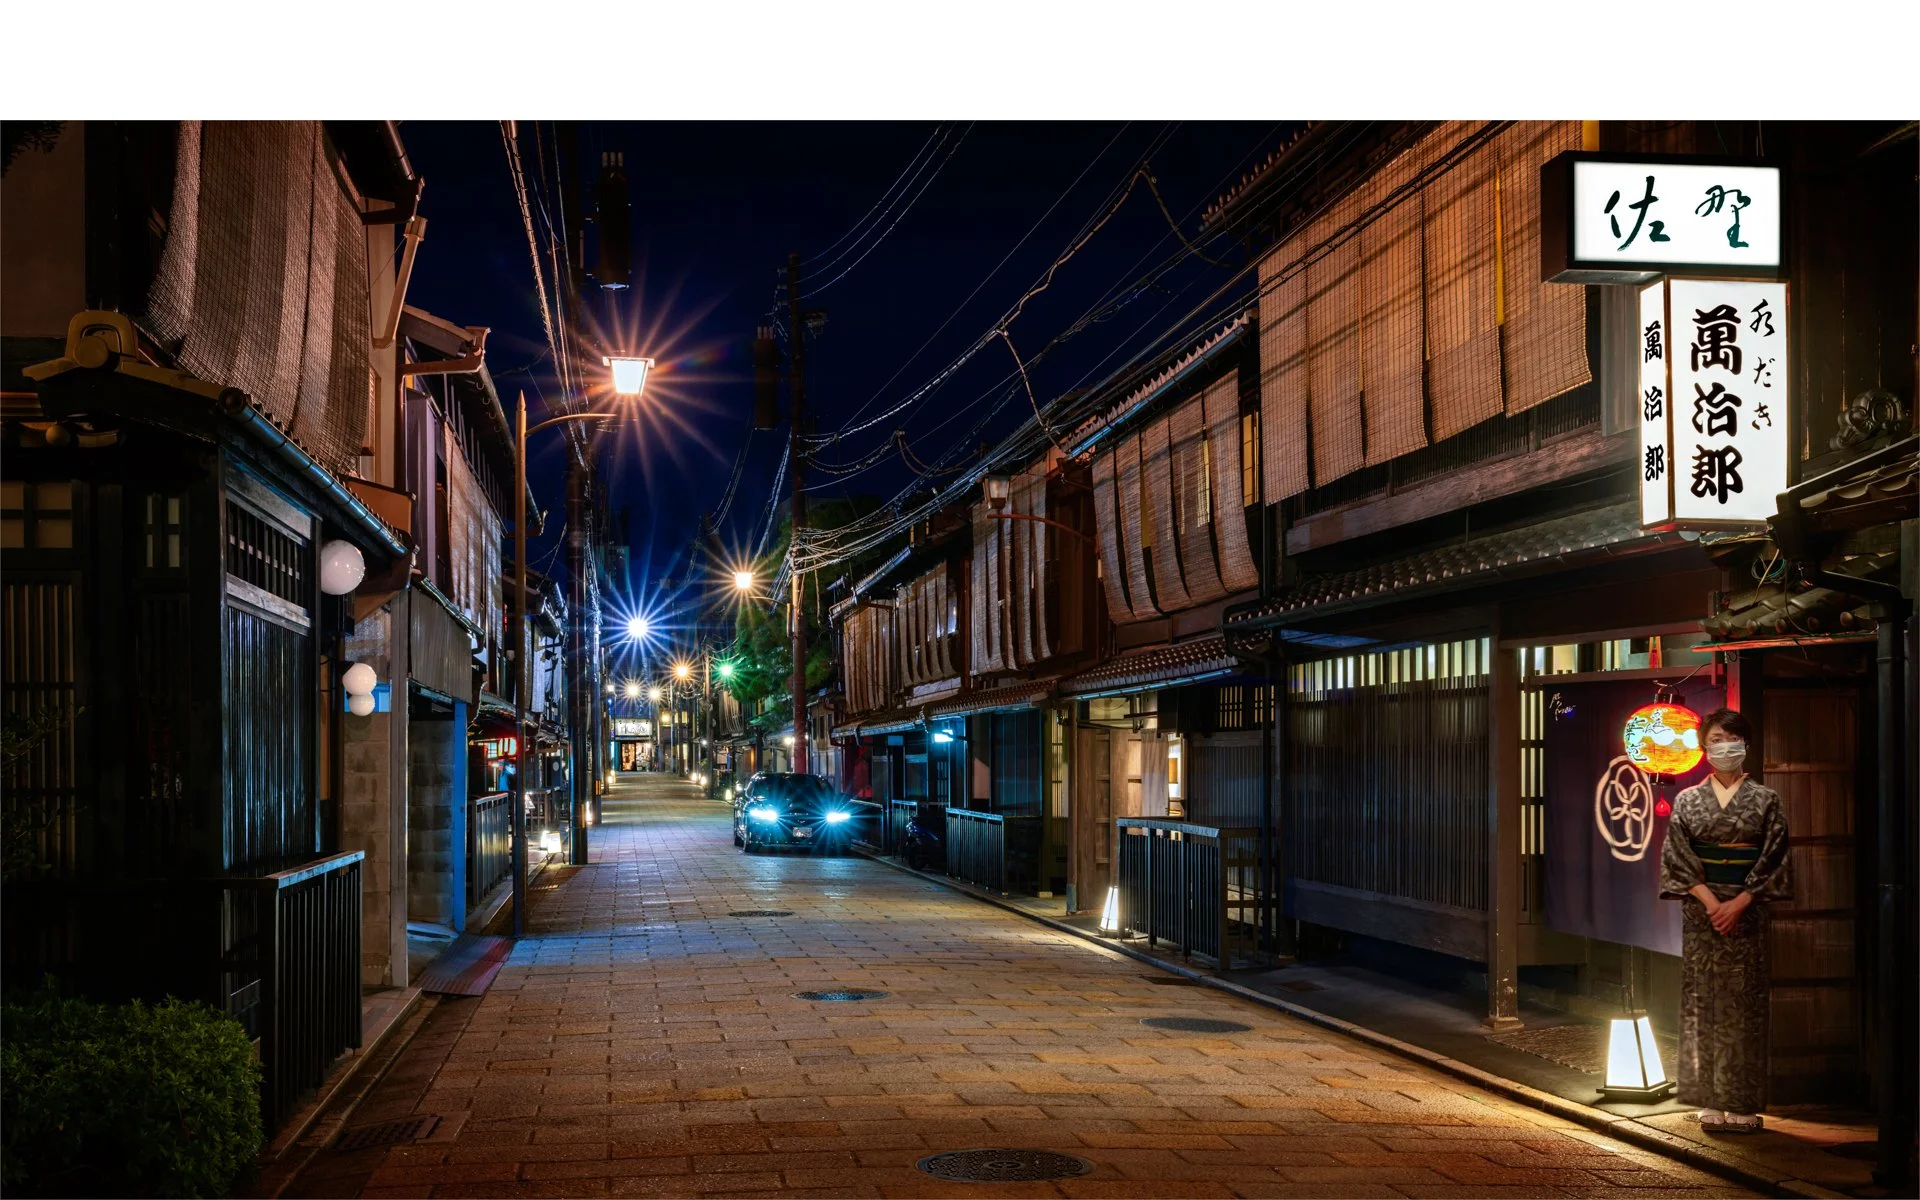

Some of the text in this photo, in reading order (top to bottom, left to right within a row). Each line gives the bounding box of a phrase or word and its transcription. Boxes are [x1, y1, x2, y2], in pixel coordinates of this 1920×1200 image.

[1644, 320, 1664, 481] 萬治郎
[1691, 304, 1743, 504] 萬治郎
